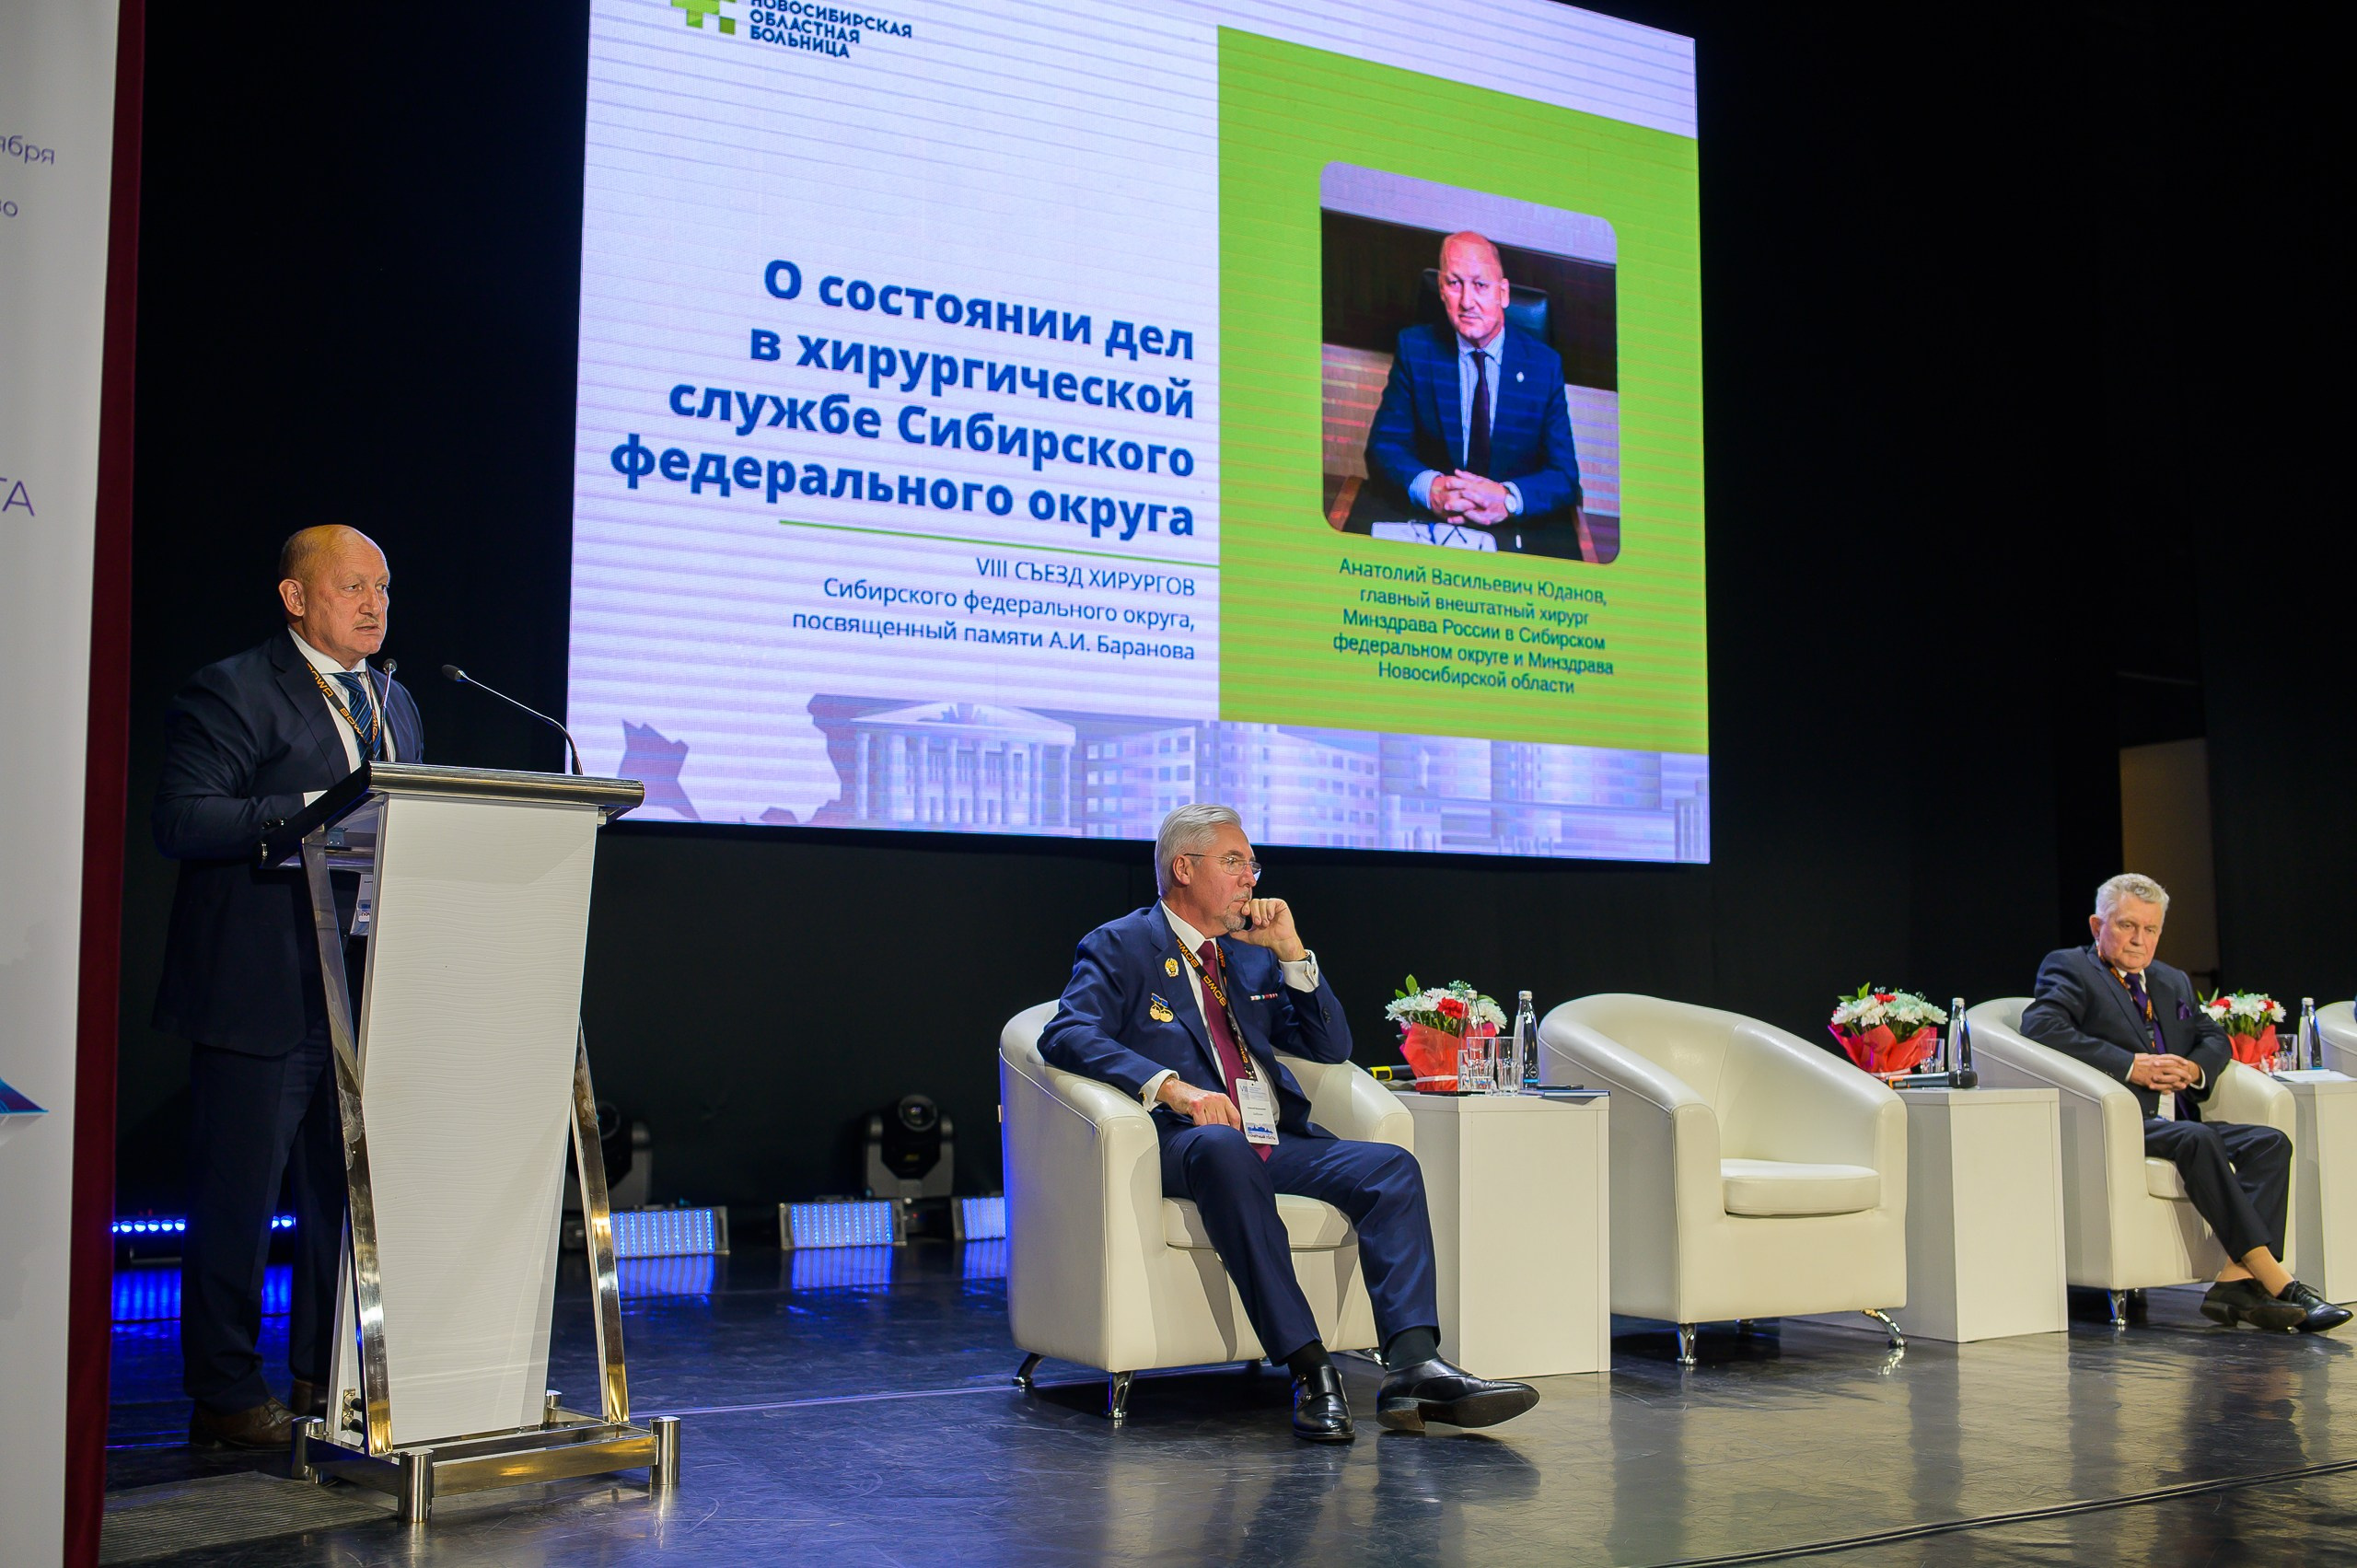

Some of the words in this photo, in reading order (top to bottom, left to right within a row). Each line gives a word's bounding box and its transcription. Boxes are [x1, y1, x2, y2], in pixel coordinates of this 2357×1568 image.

[750, 9, 860, 43] ОБЛАСТНАЯ
[750, 25, 849, 58] БОЛЬНИЦА
[0, 200, 18, 217] о
[764, 260, 801, 299] О
[819, 276, 1090, 344] состоянии
[1106, 320, 1192, 361] дел
[751, 329, 781, 361] в
[796, 335, 1192, 418] хирургической
[669, 385, 881, 438] службе
[899, 405, 1193, 476] Сибирского
[0, 477, 35, 517] А
[610, 434, 1014, 514] федерального
[1029, 490, 1193, 540] округа
[977, 558, 1006, 577] VIII
[1016, 562, 1083, 588] СЪЕЗД
[1089, 570, 1194, 596] ХИРУРГОВ
[1339, 559, 1425, 583] Анатолий
[1432, 568, 1532, 595] Васильевич
[1538, 582, 1607, 606] Юданов,
[824, 578, 957, 607] Сибирского
[965, 590, 1117, 621] федерального
[1124, 610, 1196, 633] округа,
[1361, 589, 1430, 608] главный
[1436, 598, 1534, 618] внештатный
[1540, 610, 1588, 627] хирург
[794, 614, 956, 639] посвященный
[965, 628, 1042, 646] памяти
[1098, 635, 1194, 659] Баранова
[1343, 609, 1437, 634] Минздрава
[1443, 619, 1499, 639] России
[1505, 629, 1514, 641] в
[1519, 627, 1605, 650] Сибирском
[1333, 633, 1452, 659] федеральном
[1457, 649, 1508, 666] округе
[1515, 655, 1523, 666] и
[1528, 652, 1613, 675] Минздрава
[1379, 662, 1505, 688] Новосибирской
[1511, 673, 1573, 692] области
[339, 707, 365, 738] BOW
[1202, 975, 1227, 1006] BOWA
